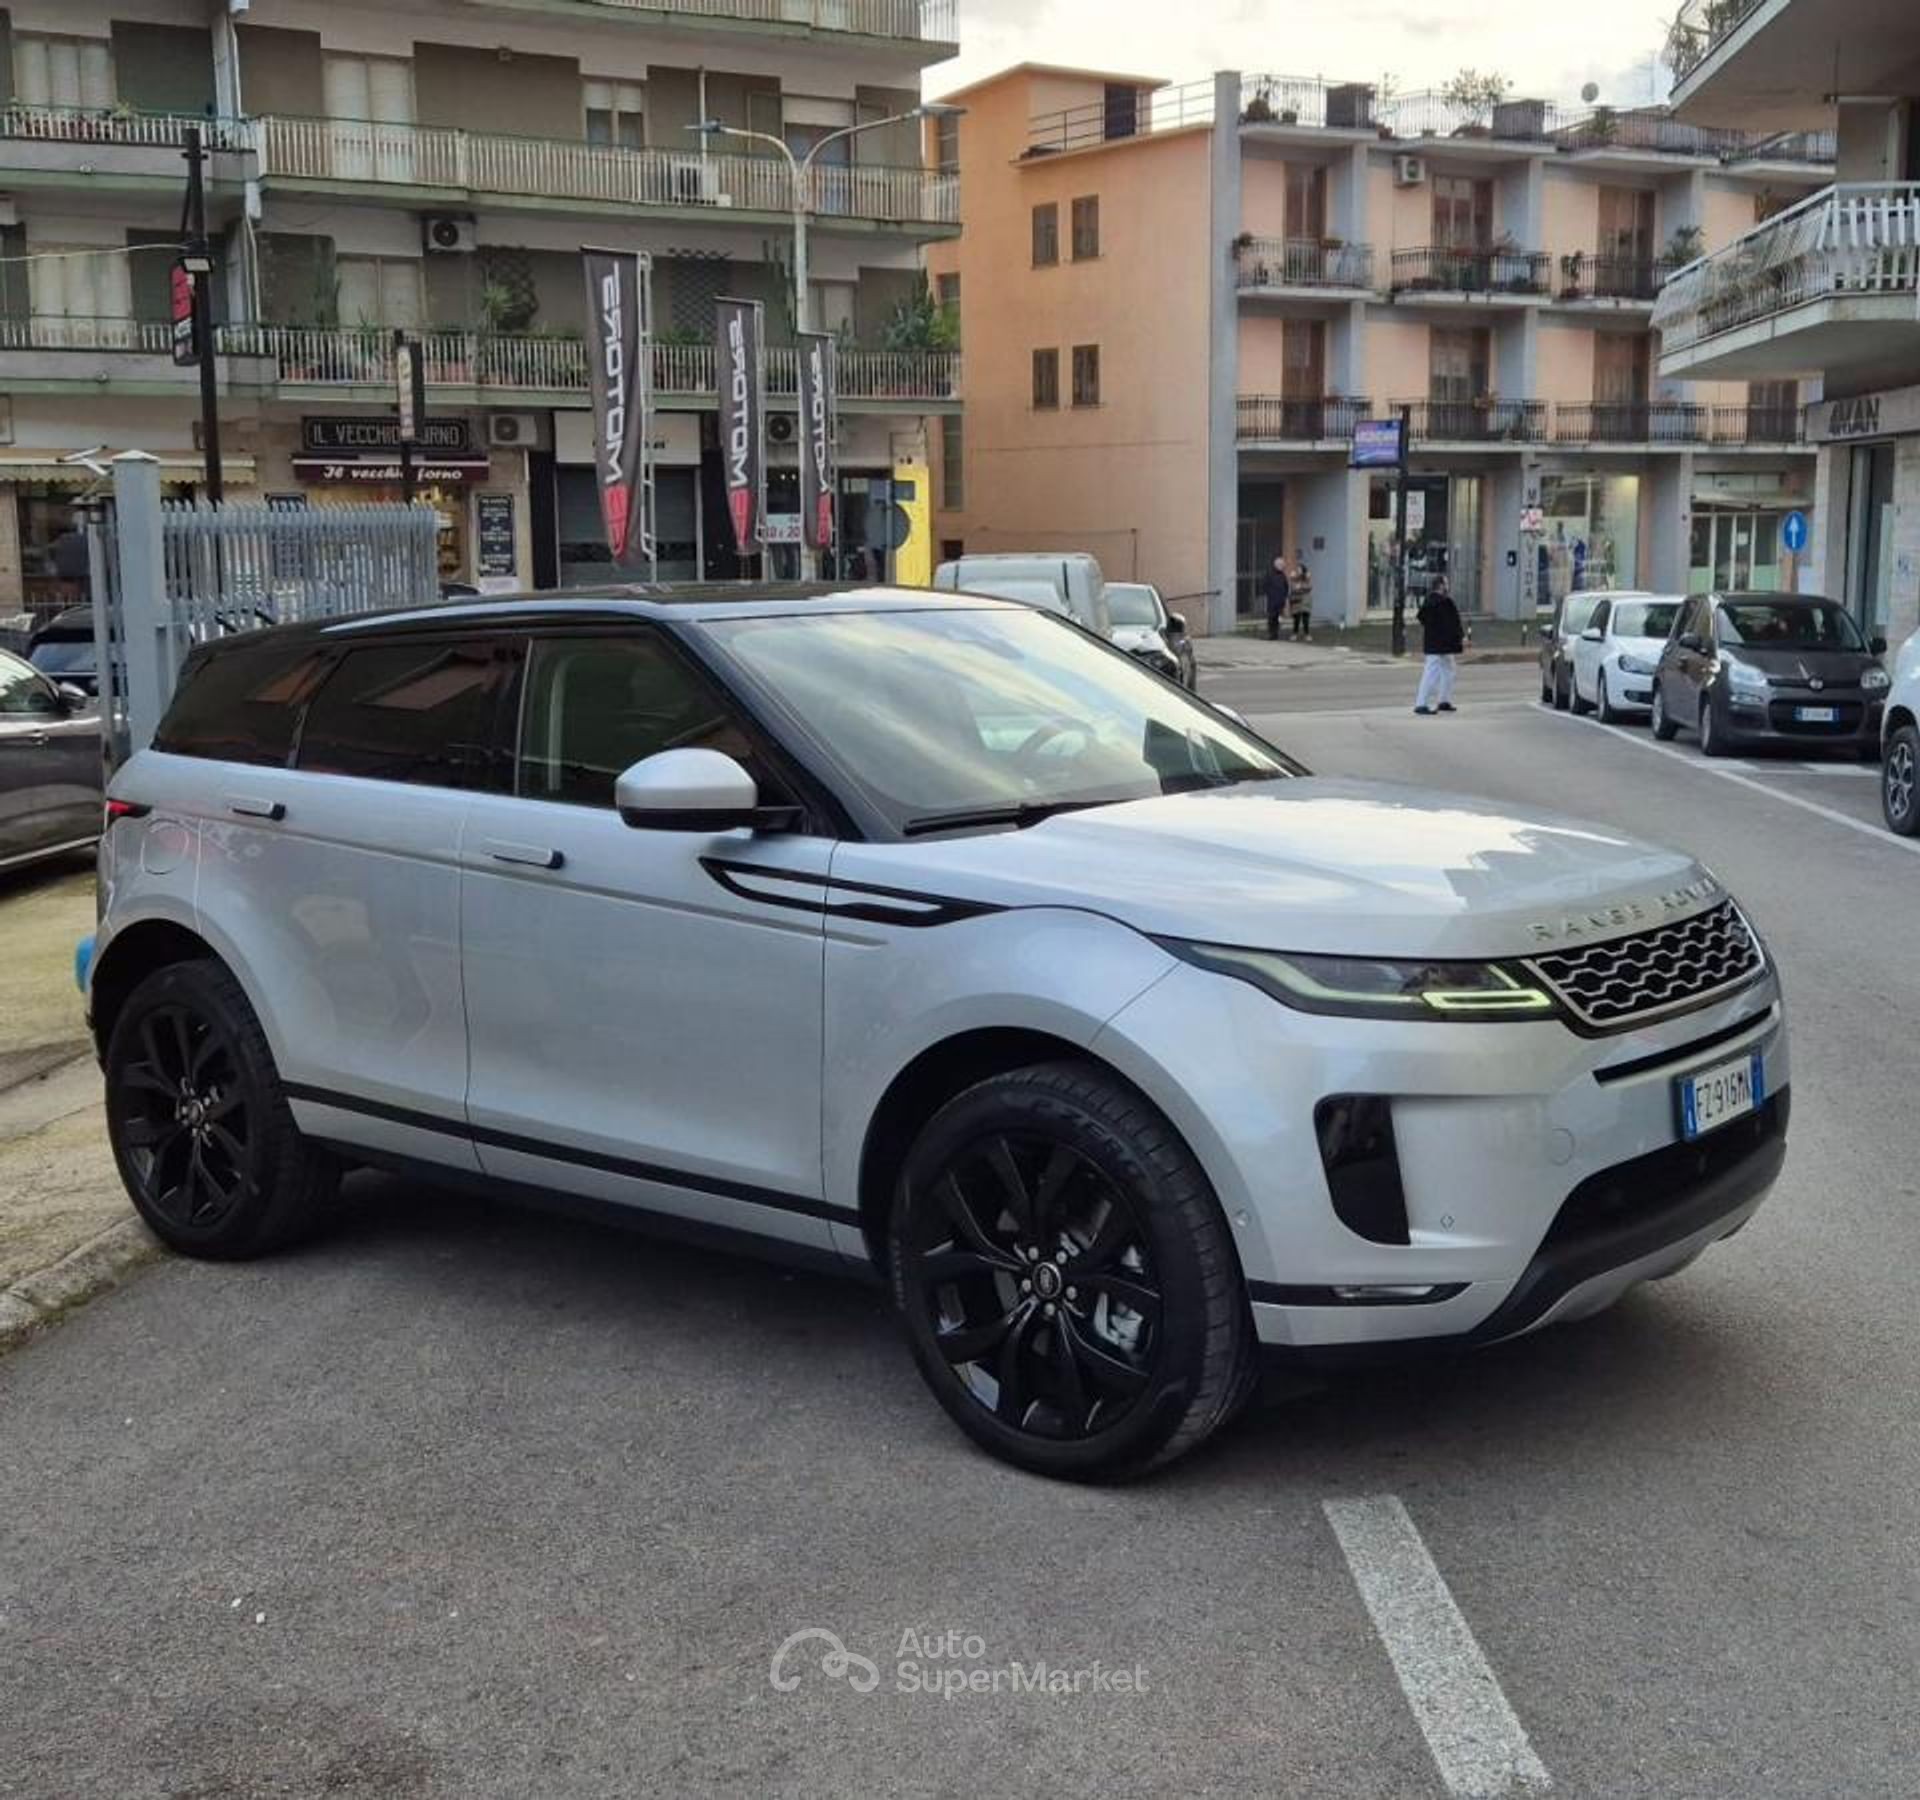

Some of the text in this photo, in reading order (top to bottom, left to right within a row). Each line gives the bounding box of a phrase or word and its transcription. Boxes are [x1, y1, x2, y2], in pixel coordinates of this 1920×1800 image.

[313, 424, 328, 443] IL
[335, 424, 400, 445] VECCHIO
[417, 468, 462, 482] forno
[1526, 903, 1646, 942] RANGE
